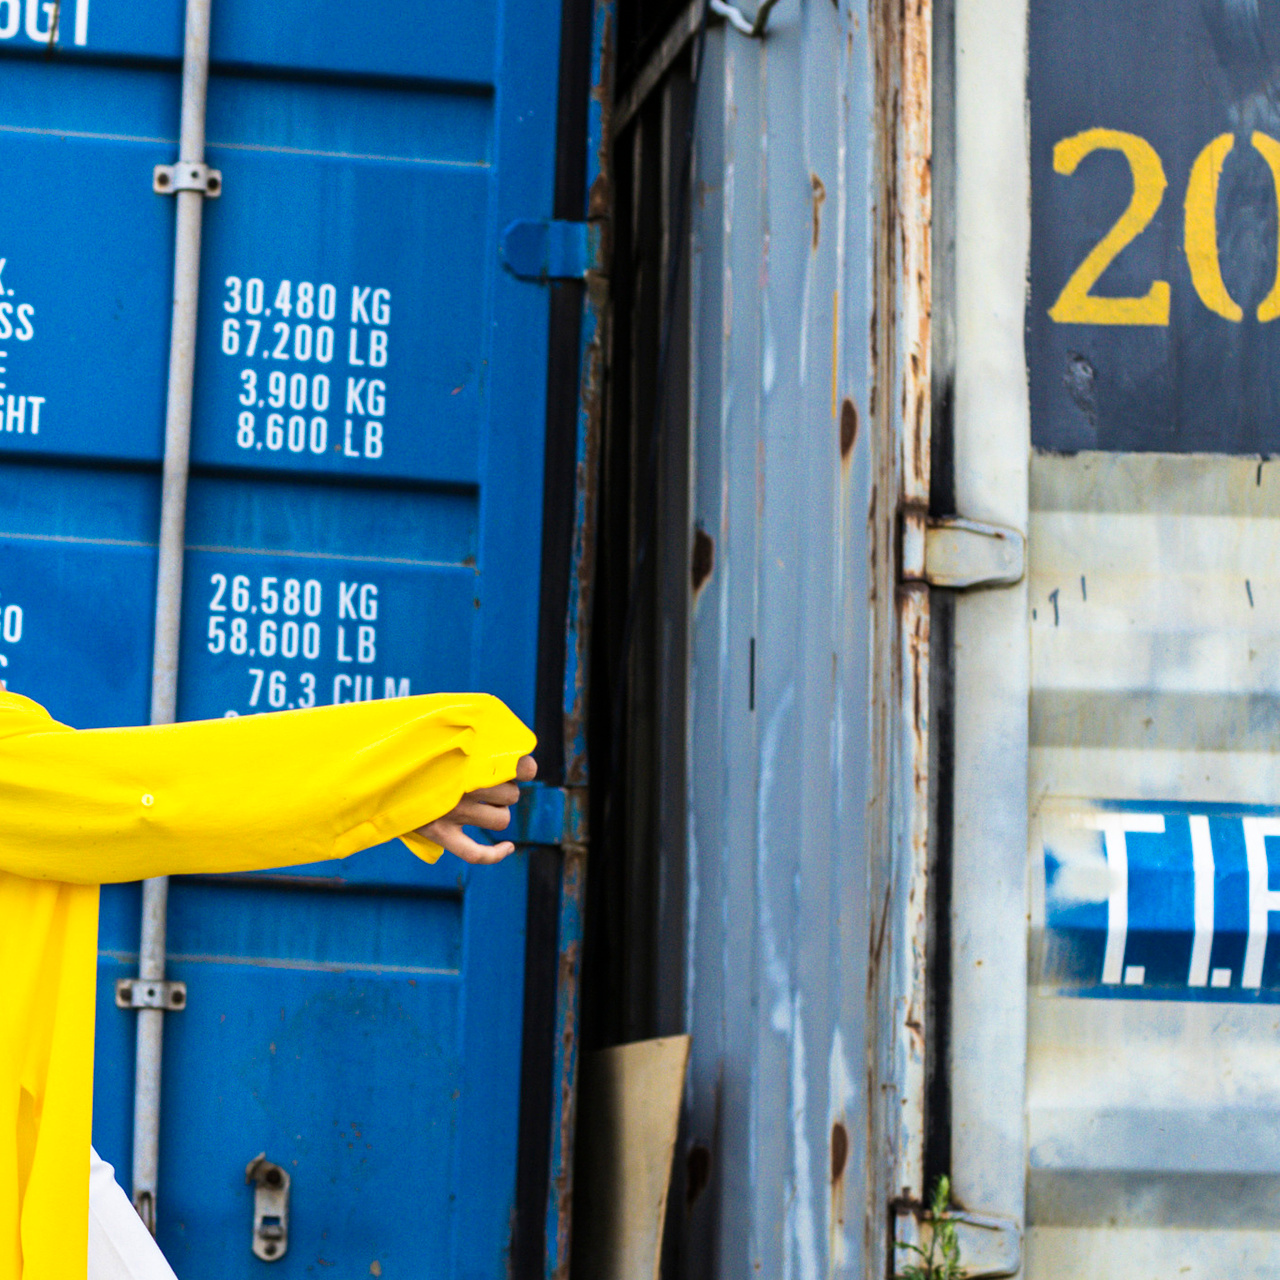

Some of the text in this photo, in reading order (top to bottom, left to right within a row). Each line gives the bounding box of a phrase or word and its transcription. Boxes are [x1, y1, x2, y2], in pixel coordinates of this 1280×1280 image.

[1047, 127, 1280, 326] 20
[350, 285, 391, 326] KG
[348, 327, 388, 368] LB
[346, 376, 386, 417] KG
[343, 419, 384, 459] LB
[338, 581, 378, 621] KG
[336, 625, 376, 664] LB
[248, 668, 316, 710] 76.3
